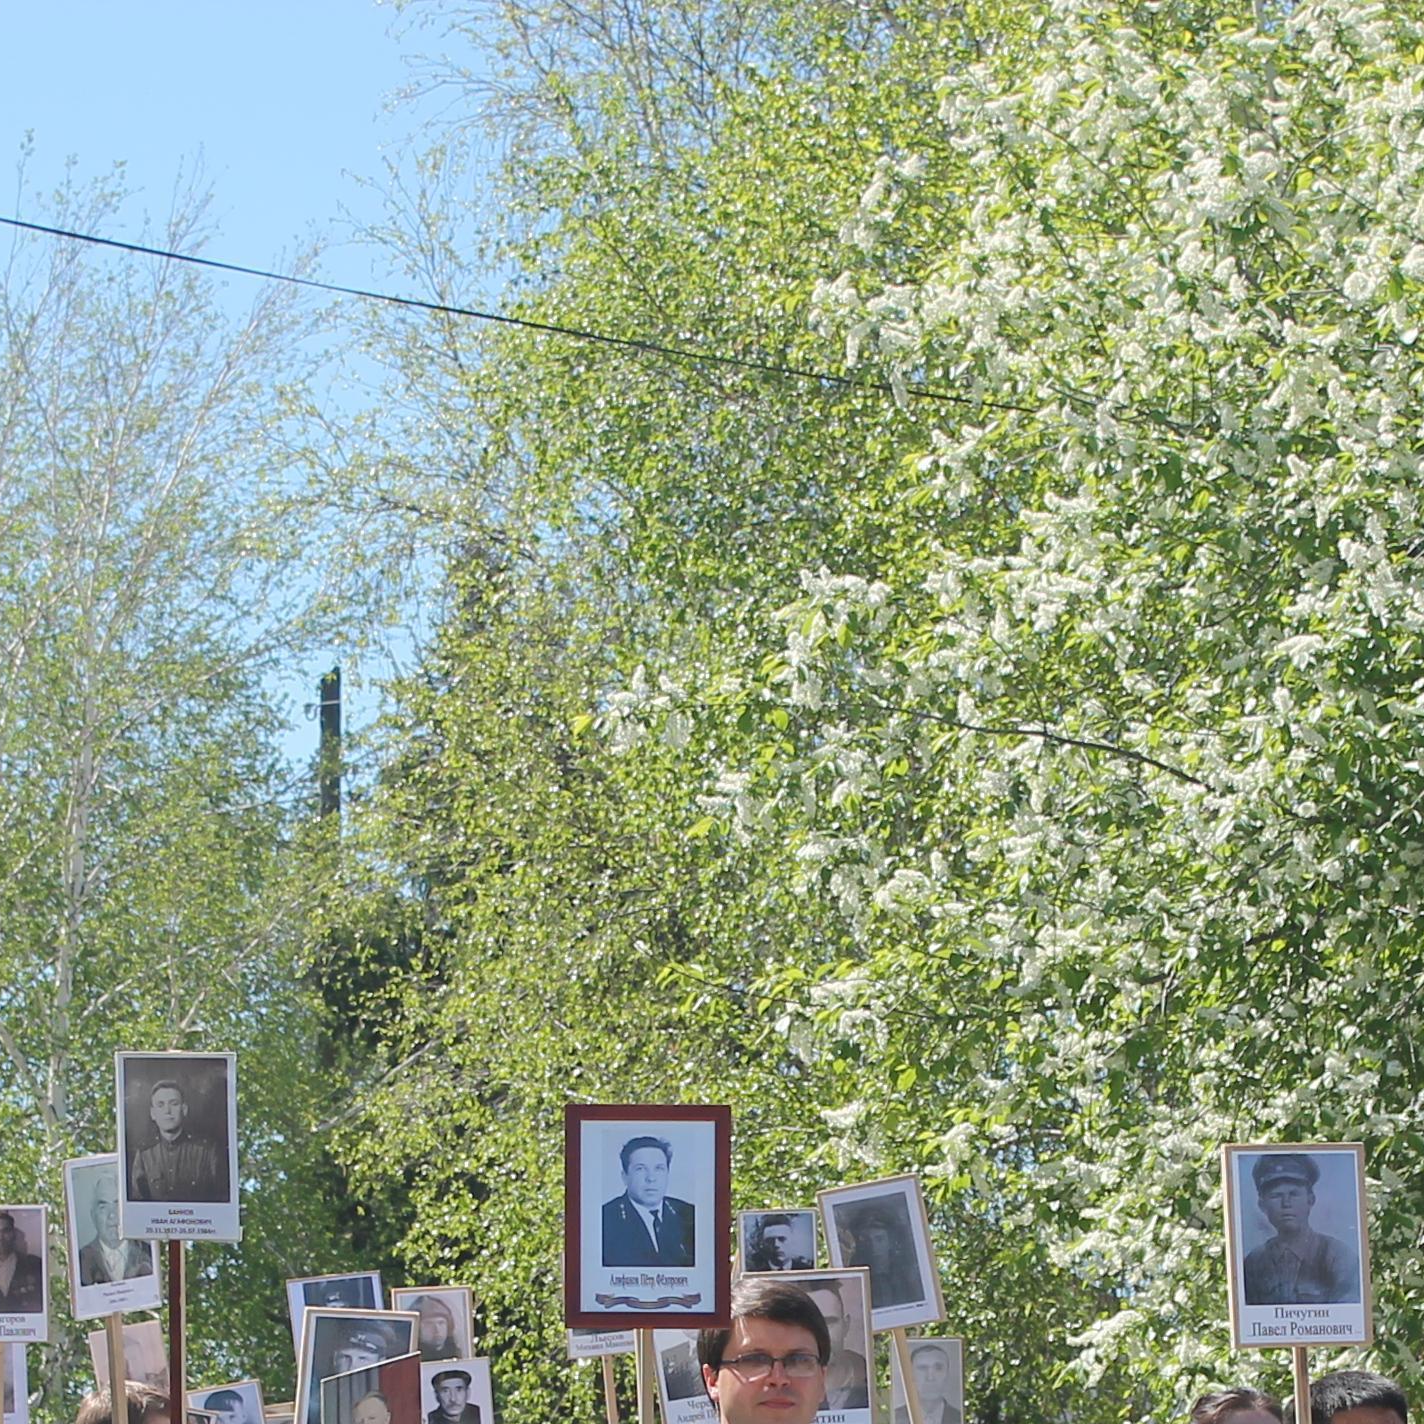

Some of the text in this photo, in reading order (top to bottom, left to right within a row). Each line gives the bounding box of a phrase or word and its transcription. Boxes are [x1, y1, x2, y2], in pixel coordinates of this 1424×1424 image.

[1274, 1307, 1330, 1321] Пичугин
[0, 1325, 36, 1337] Павлович
[1252, 1321, 1353, 1337] Павел Романович
[676, 1413, 706, 1424] Андрей
